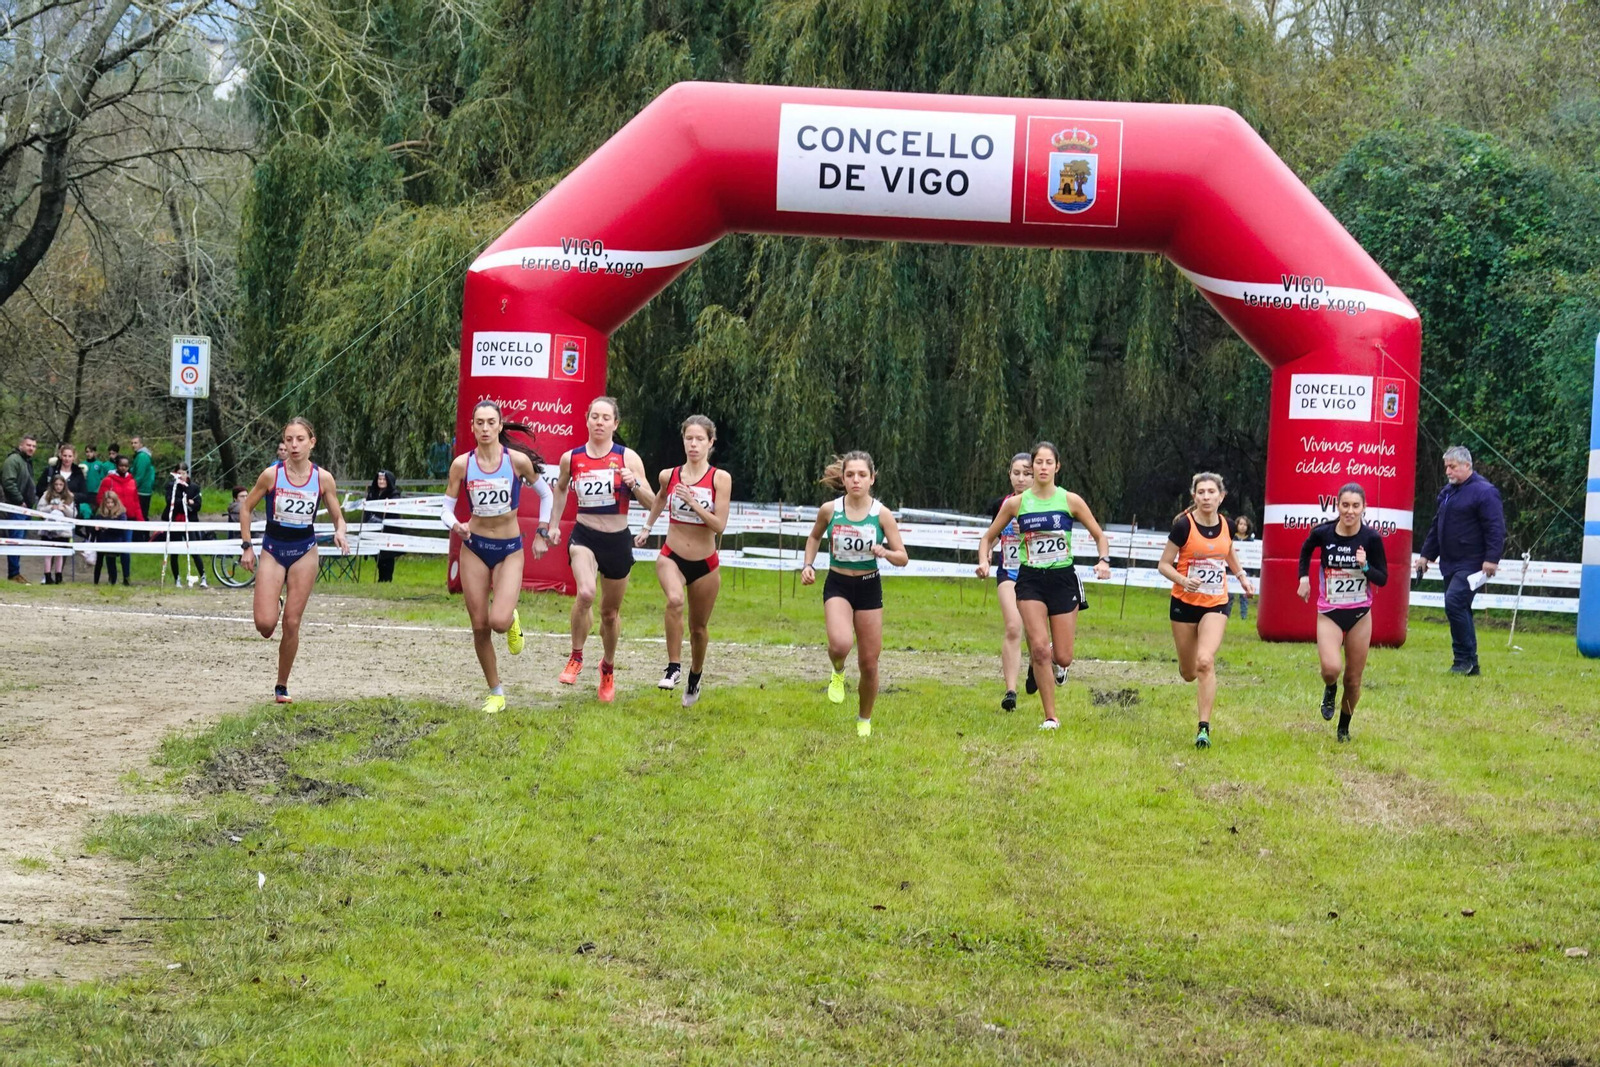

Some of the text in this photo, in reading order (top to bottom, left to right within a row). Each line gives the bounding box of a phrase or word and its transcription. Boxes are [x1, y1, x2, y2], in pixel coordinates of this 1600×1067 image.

[797, 125, 994, 160] CONCELLO
[819, 163, 969, 196] DE VIGO
[561, 237, 608, 260] VIGO,
[521, 255, 644, 277] terreo de xogo
[1281, 275, 1329, 296] VIGO,
[1243, 291, 1366, 316] terreo de xogo
[476, 341, 543, 354] CONCELLO
[481, 355, 533, 367] DE VIGO
[1294, 384, 1365, 397] CONCELLO
[531, 398, 573, 415] nunha
[1301, 398, 1356, 410] DE VIGO
[1300, 436, 1395, 456] Vivimos nunha
[1295, 458, 1396, 478] cidade fermosa
[584, 481, 612, 496] 221
[478, 489, 509, 506] 220
[284, 498, 315, 515] 223
[843, 537, 873, 552] 301
[1037, 537, 1066, 554] 226
[1197, 570, 1224, 584] 225
[1335, 579, 1365, 593] 227
